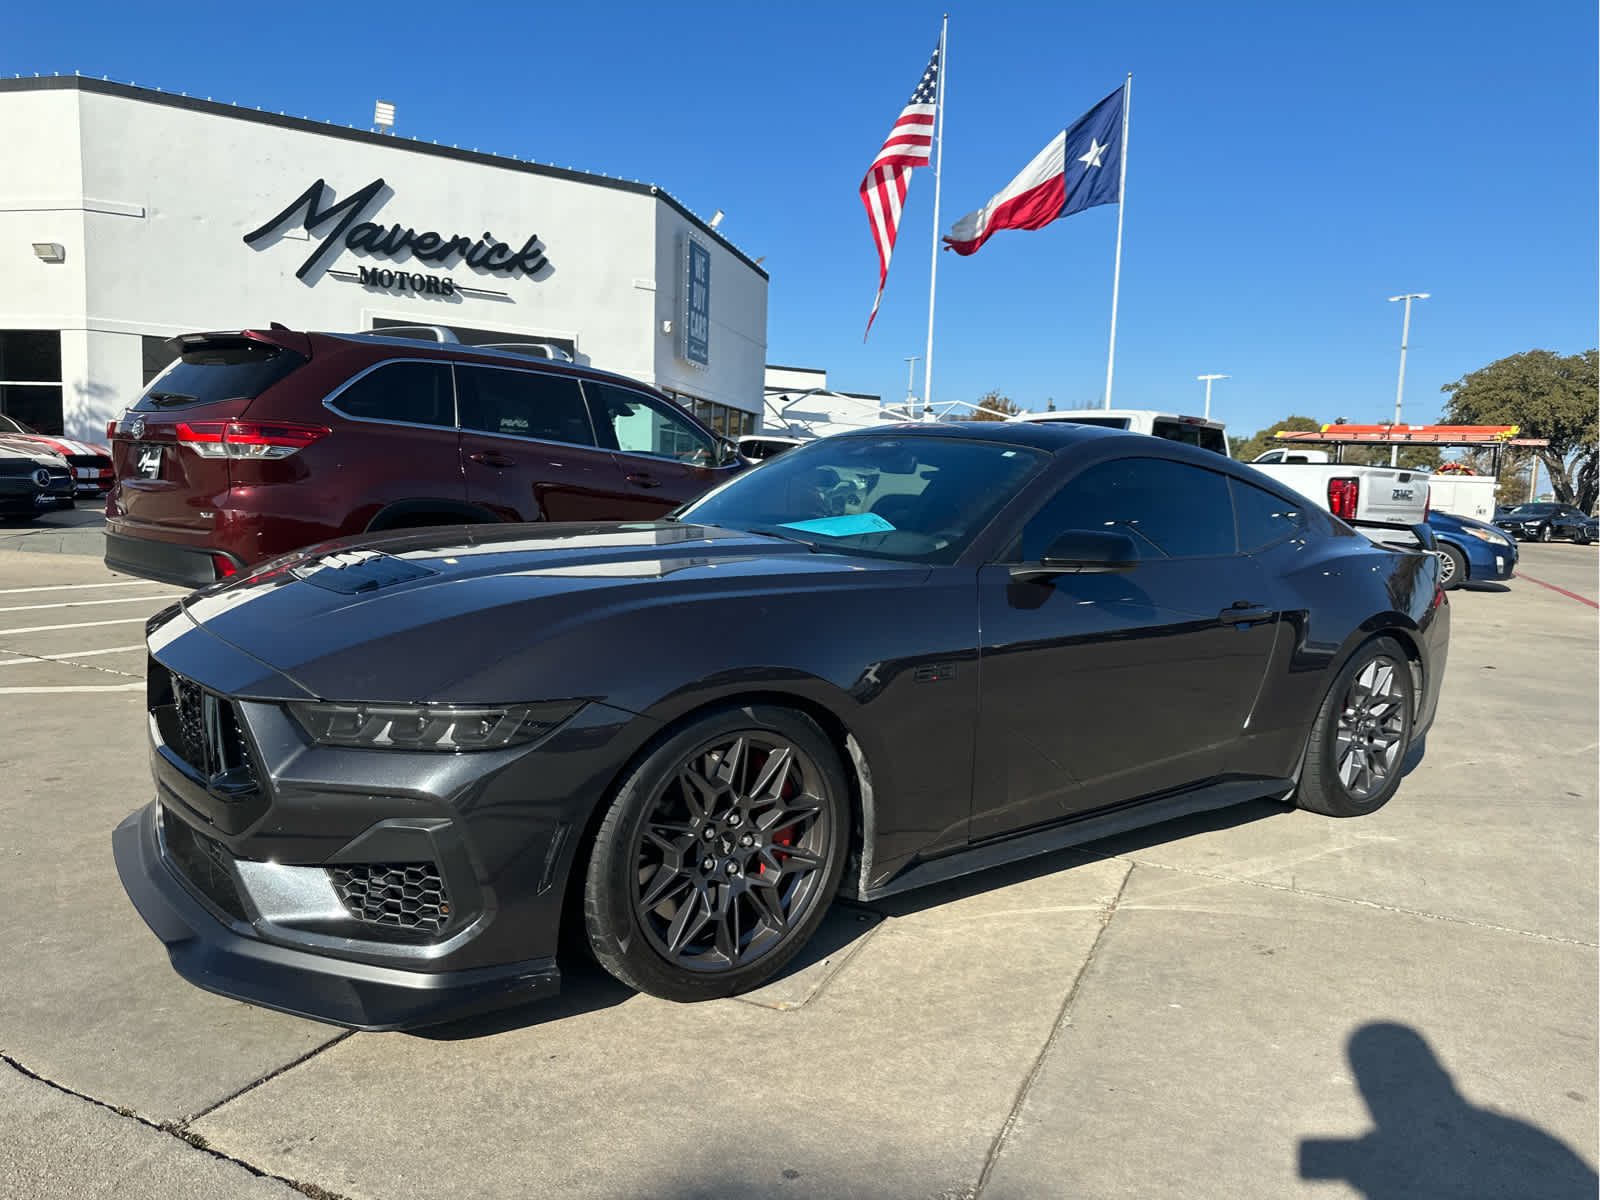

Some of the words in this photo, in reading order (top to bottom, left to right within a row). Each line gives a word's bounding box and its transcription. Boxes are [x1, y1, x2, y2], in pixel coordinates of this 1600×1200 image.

[243, 178, 549, 278] Maverick
[357, 265, 455, 296] MOTORS
[694, 250, 706, 282] WE
